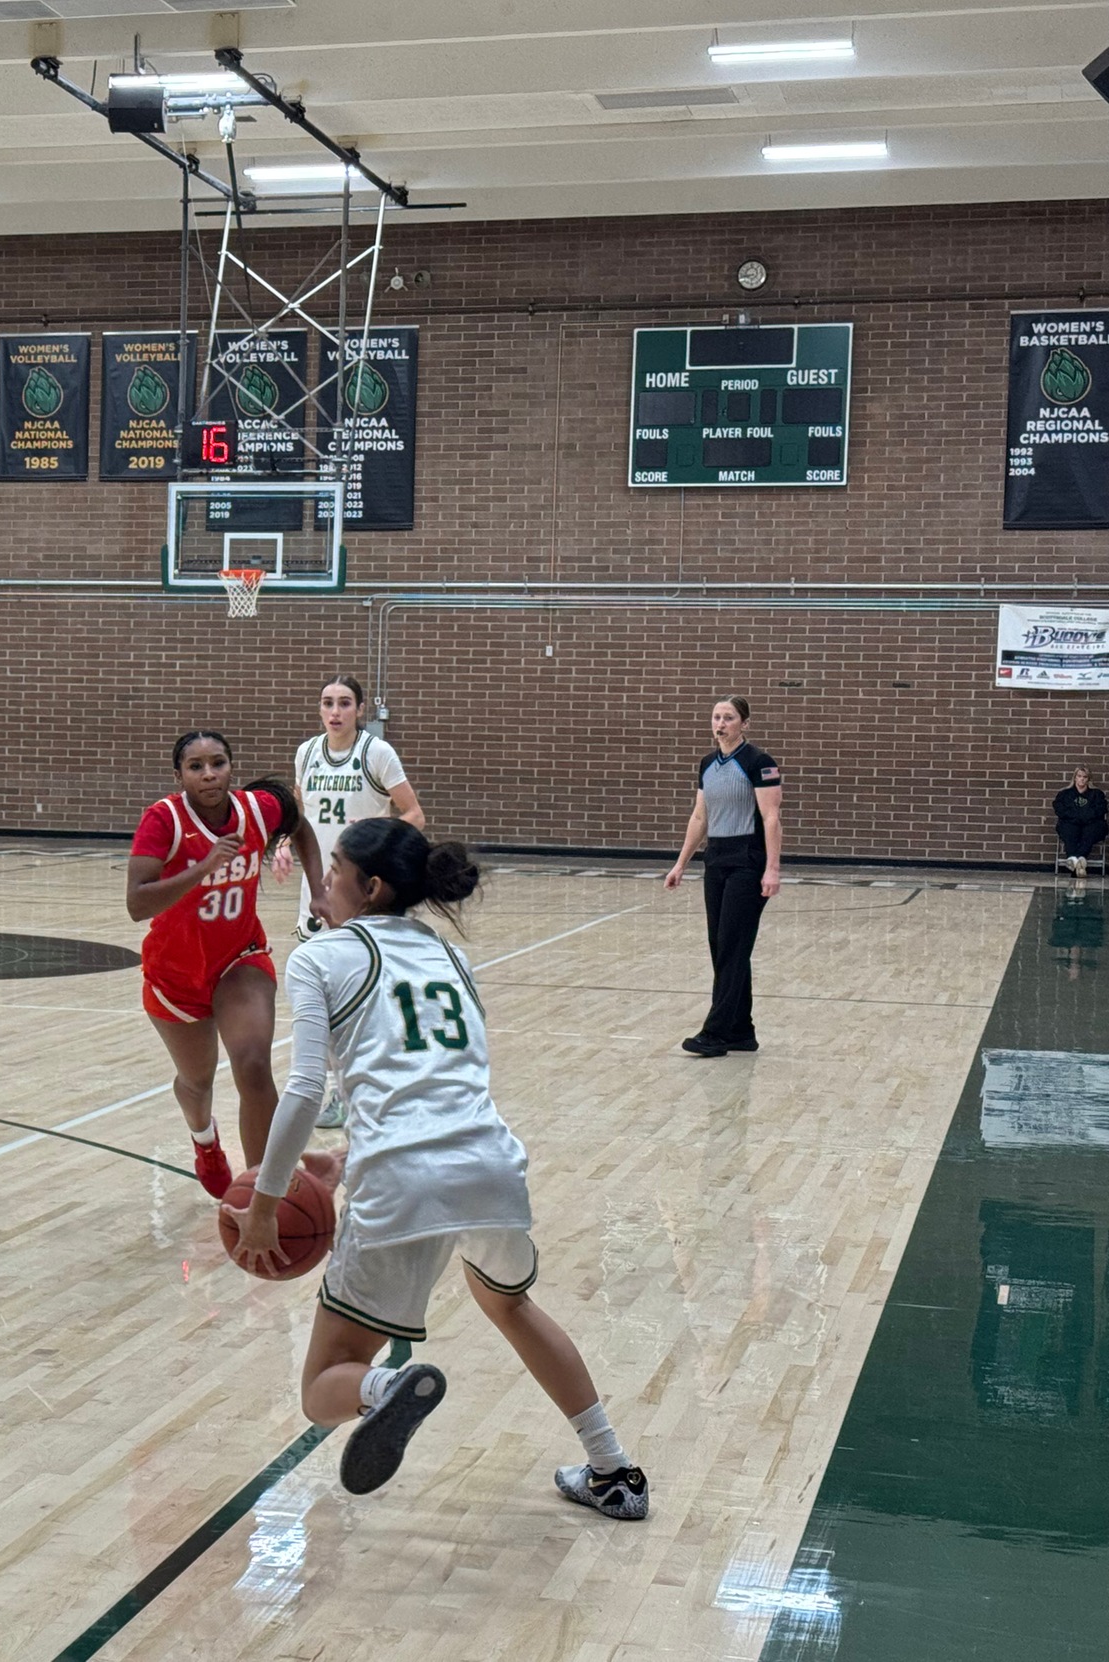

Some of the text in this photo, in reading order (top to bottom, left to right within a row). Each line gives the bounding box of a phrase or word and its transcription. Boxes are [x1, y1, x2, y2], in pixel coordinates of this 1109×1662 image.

[1032, 321, 1105, 334] WOMEN'S
[1020, 334, 1109, 347] BASKETBAL
[18, 344, 69, 354] WOMEN'S
[123, 343, 176, 352] WOMEN'S
[10, 354, 77, 364] VOLLEYBALL
[645, 372, 690, 388] HOME
[787, 369, 838, 385] GUEST
[721, 379, 759, 390] PERIOD
[1039, 407, 1091, 418] NJCAA
[24, 421, 60, 429] NJCAA
[129, 420, 166, 429] NJCAA
[1026, 420, 1103, 431] REGIONAL
[15, 431, 69, 439] NATIONAL
[120, 430, 175, 438] NATIONAL
[636, 428, 669, 439] FOULS
[702, 427, 774, 439] PLAYER FOUL
[808, 426, 843, 437] FOULS
[115, 439, 179, 448] CHAMPIONS
[1019, 432, 1109, 445] CHAMPIONS
[10, 440, 73, 449] CHAMPIONS
[202, 427, 228, 463] 16
[1010, 447, 1034, 456] 1992
[24, 457, 59, 469] 1985
[128, 456, 165, 469] 2019
[1009, 457, 1033, 466] 1993
[634, 471, 668, 482] SCORE
[718, 471, 755, 482] MATCH
[806, 470, 840, 481] SCORE
[1008, 467, 1035, 476] 2004
[209, 502, 232, 510] 2005
[209, 511, 230, 519] 2019
[306, 775, 363, 791] ARTICHOKES
[319, 798, 345, 824] 24
[198, 886, 244, 920] 30
[393, 980, 469, 1052] 13
